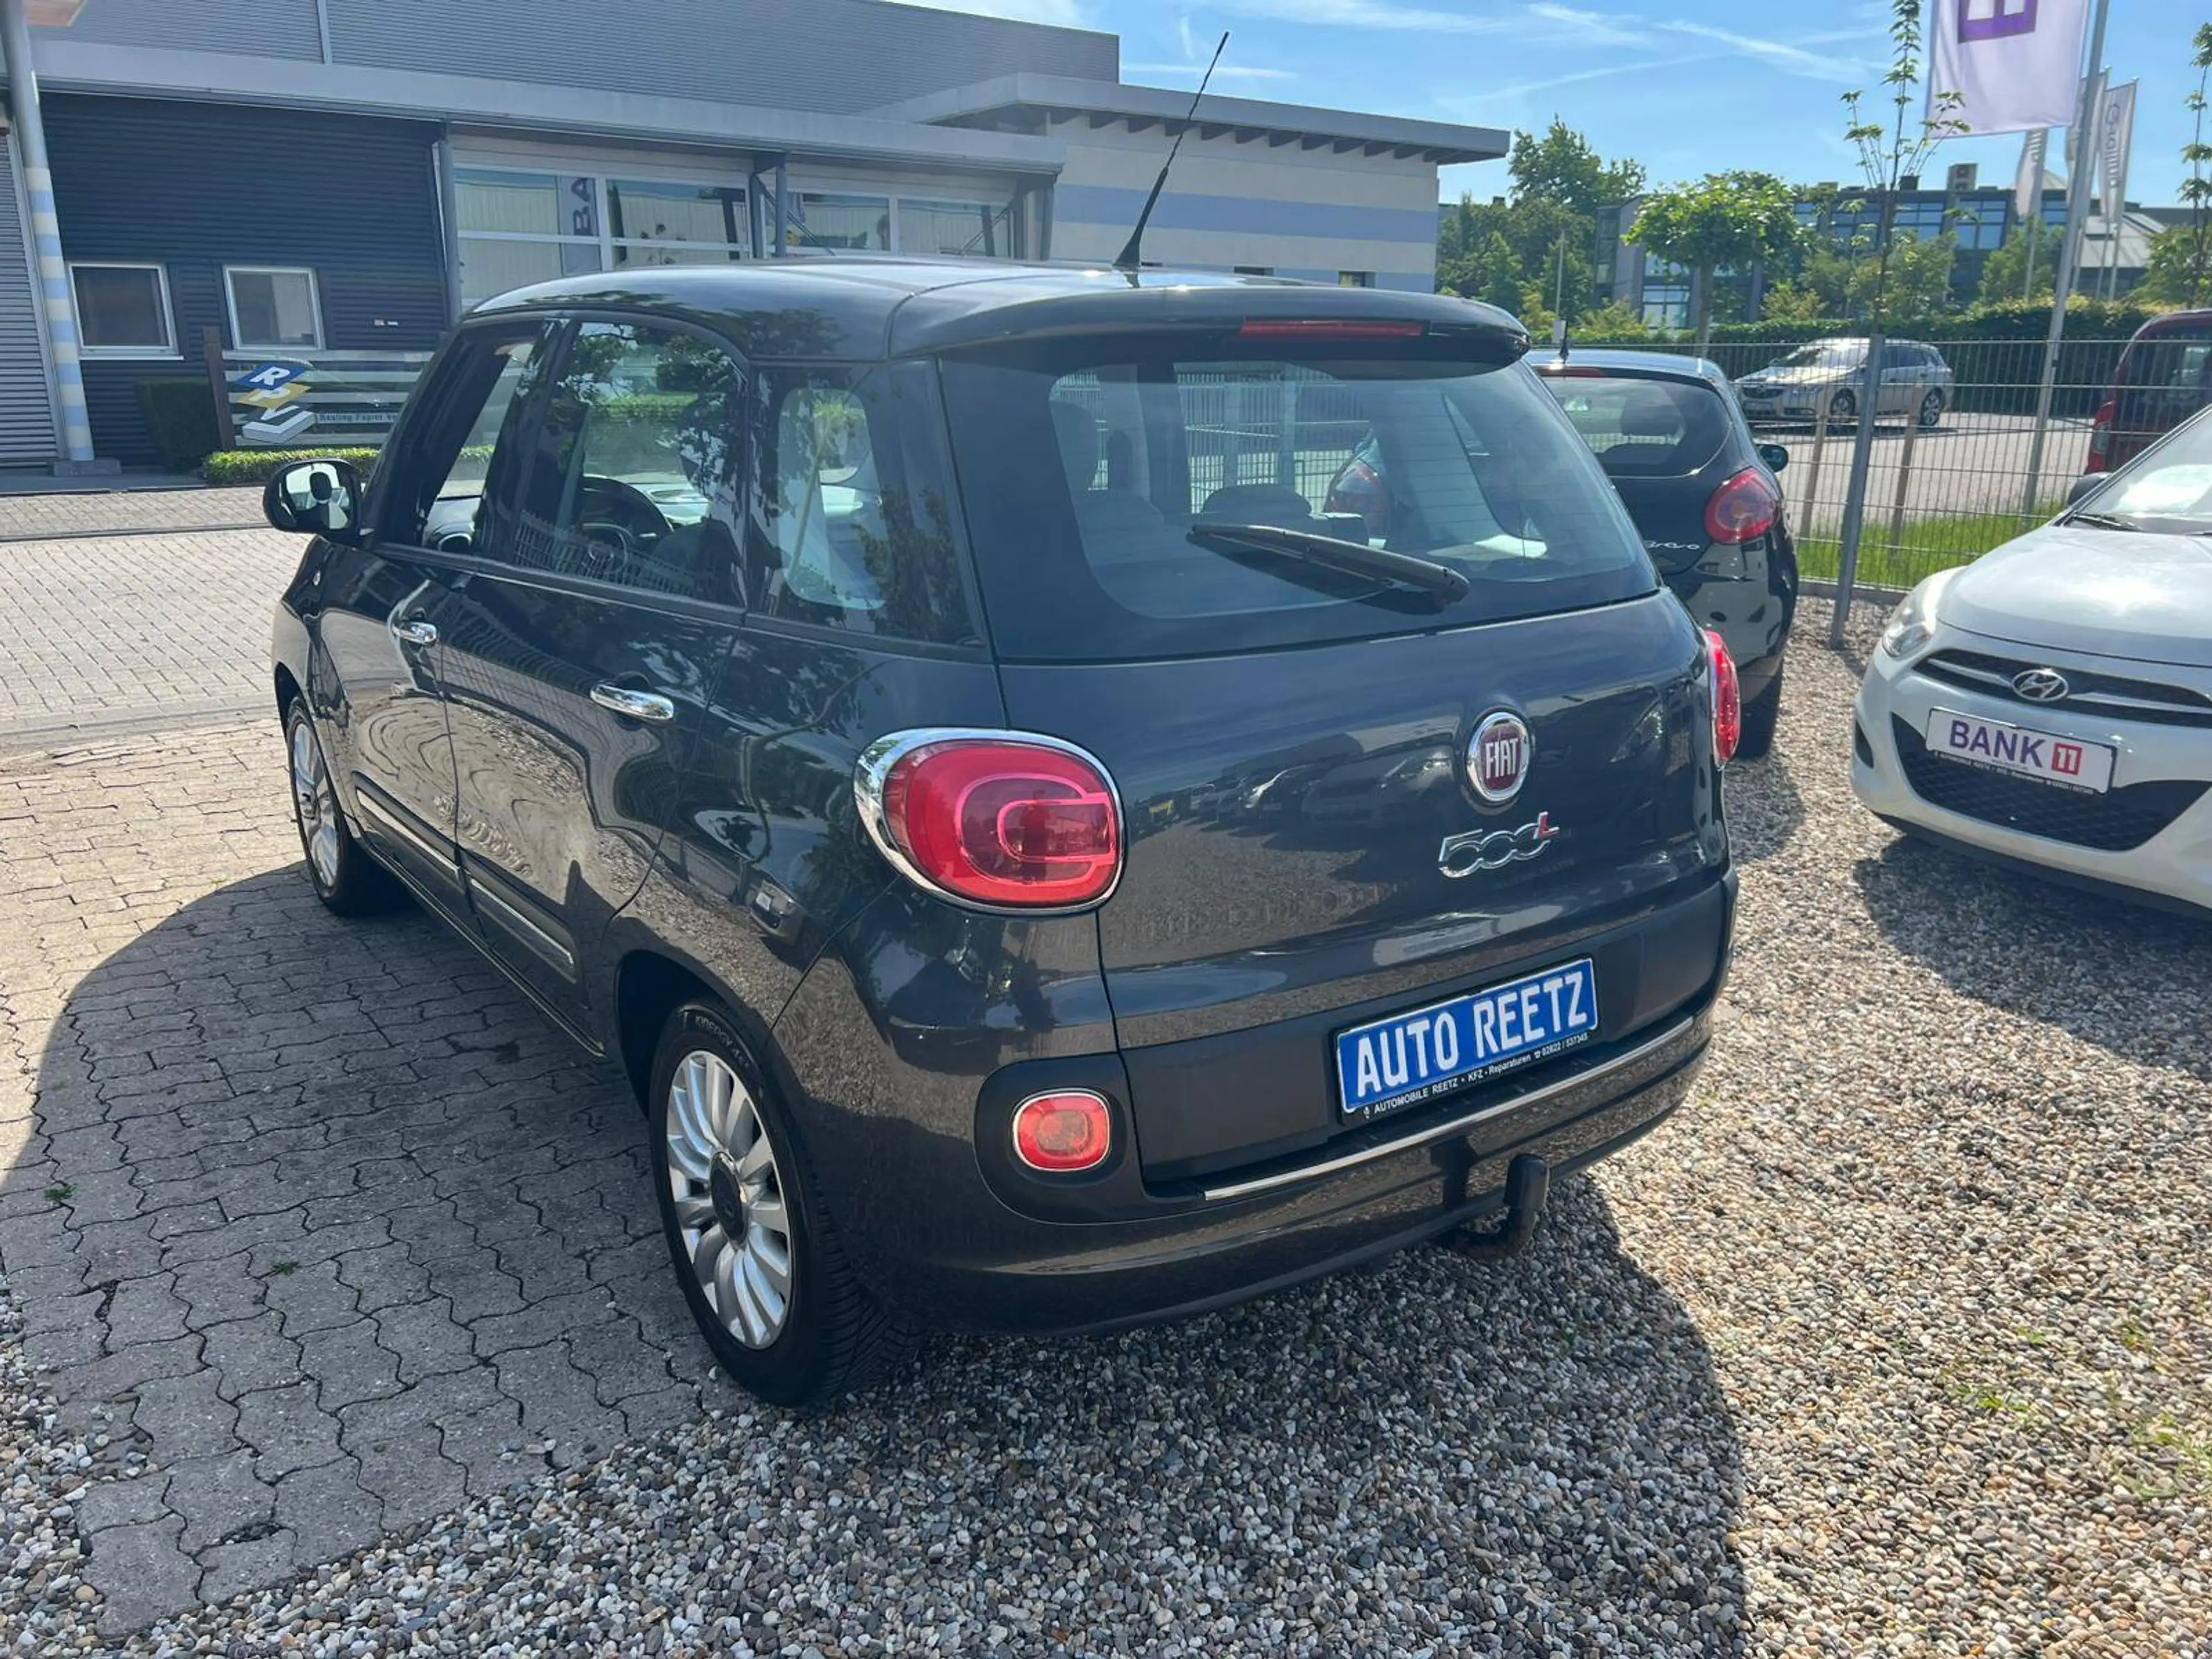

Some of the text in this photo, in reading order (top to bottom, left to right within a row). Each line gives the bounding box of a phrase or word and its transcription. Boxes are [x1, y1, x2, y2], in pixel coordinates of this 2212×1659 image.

[1484, 737, 1519, 779] FIAT
[1949, 719, 2046, 767] BANK
[1357, 971, 1588, 1097] AUTO REETZ
[1374, 1088, 1429, 1113] AUTOMOBILE
[1432, 1078, 1459, 1094] REETZ
[1468, 1070, 1484, 1082] KFZ
[1488, 1054, 1532, 1074] Reparaturen
